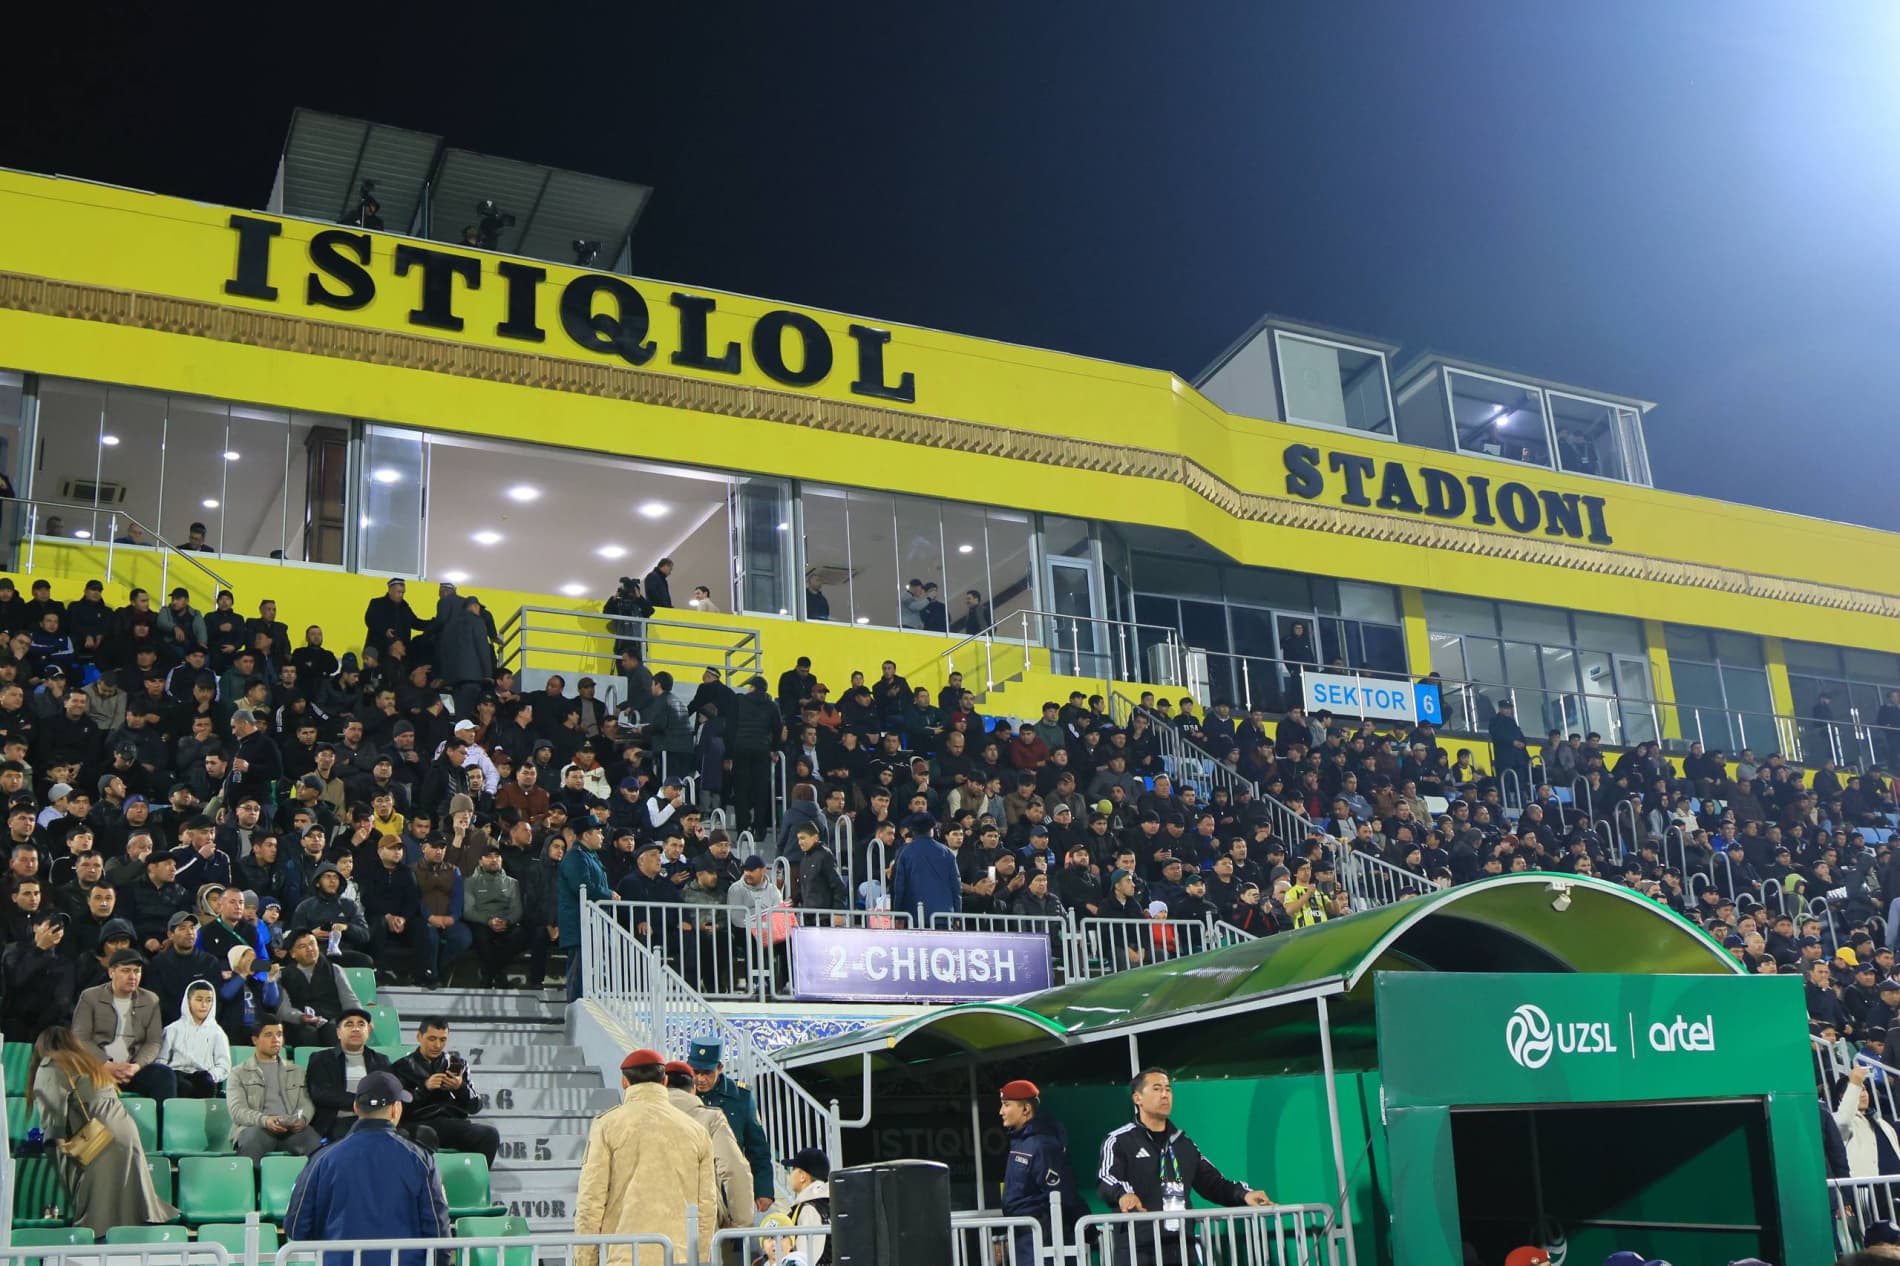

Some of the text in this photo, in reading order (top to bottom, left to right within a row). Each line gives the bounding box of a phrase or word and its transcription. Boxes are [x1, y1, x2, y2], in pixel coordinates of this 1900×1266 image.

[224, 214, 916, 403] ISTIQLOL
[1283, 444, 1613, 545] STADIONI
[1314, 683, 1435, 714] SEKTOR 6
[828, 945, 1016, 983] 2-CHIQISH
[1557, 1014, 1716, 1053] UZSL artel
[497, 1088, 514, 1110] 6
[535, 1138, 552, 1161] 5
[872, 1128, 1009, 1158] ISTIQLO
